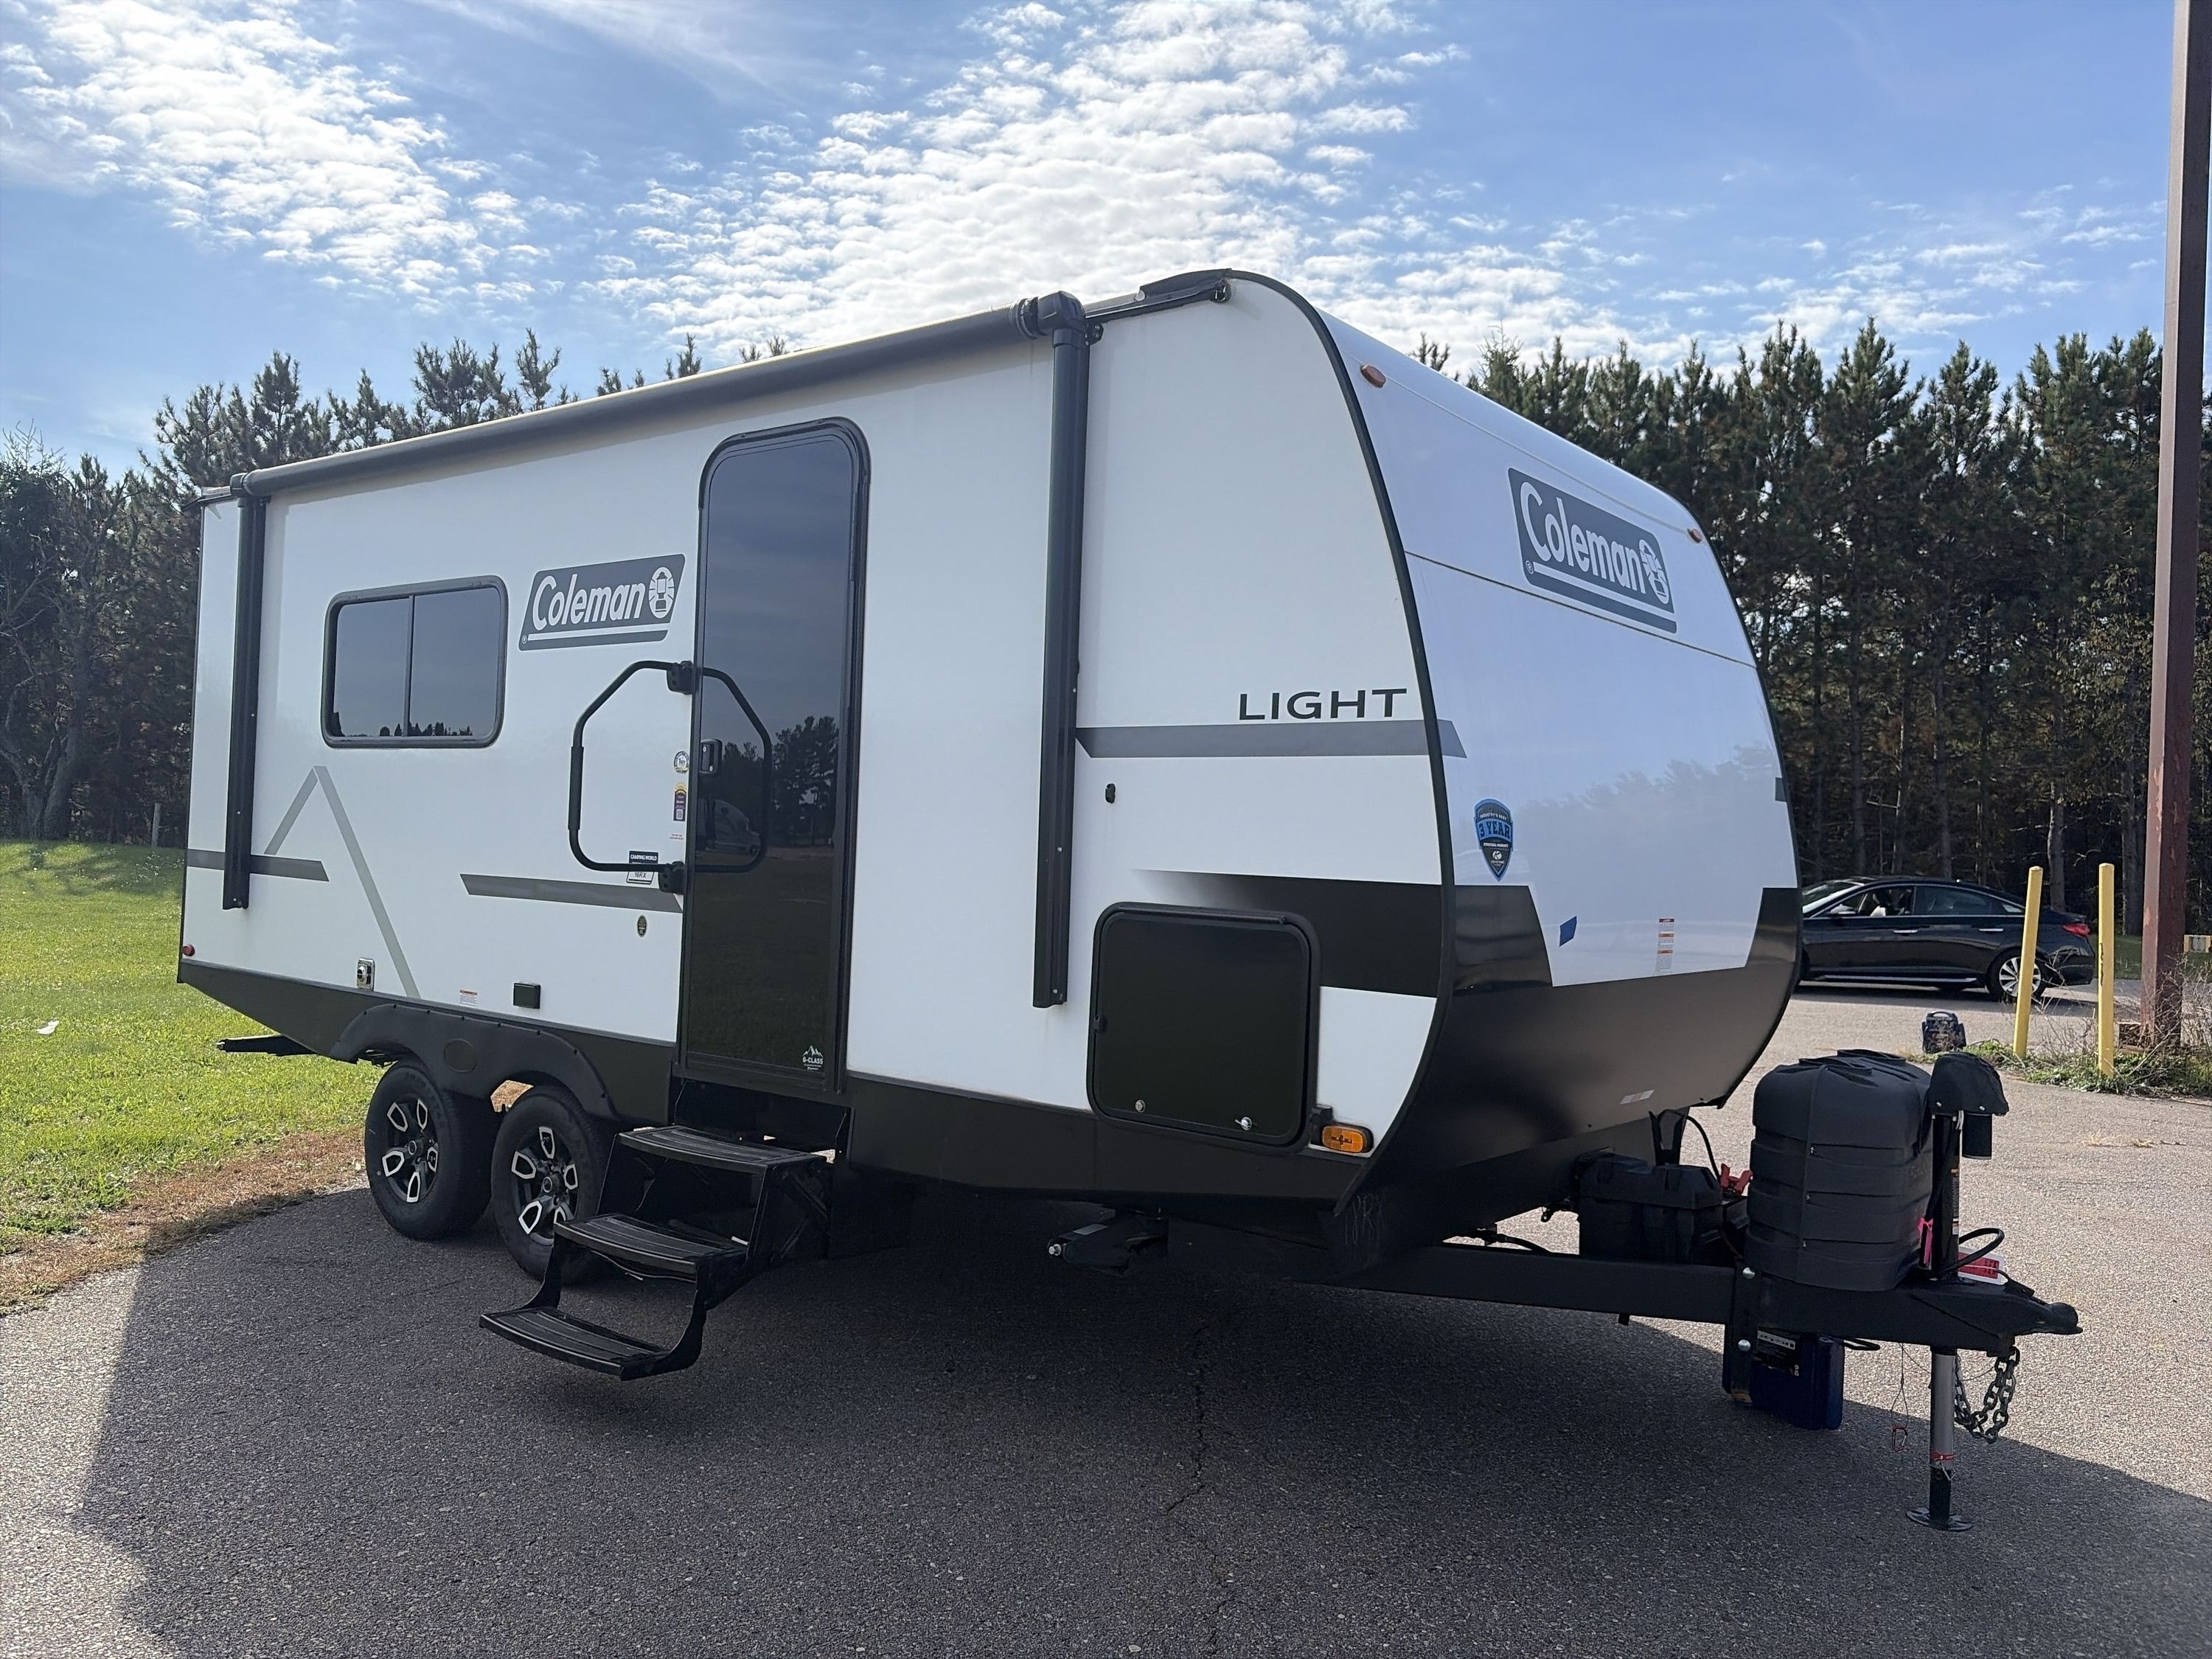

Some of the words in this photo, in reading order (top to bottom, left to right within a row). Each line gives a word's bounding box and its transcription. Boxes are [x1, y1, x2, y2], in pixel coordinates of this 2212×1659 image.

[1520, 481, 1646, 594] Coleman
[532, 574, 646, 630] Coleman
[1239, 688, 1408, 720] LIGHT
[1478, 823, 1485, 838] 3
[1486, 821, 1510, 839] YEAR
